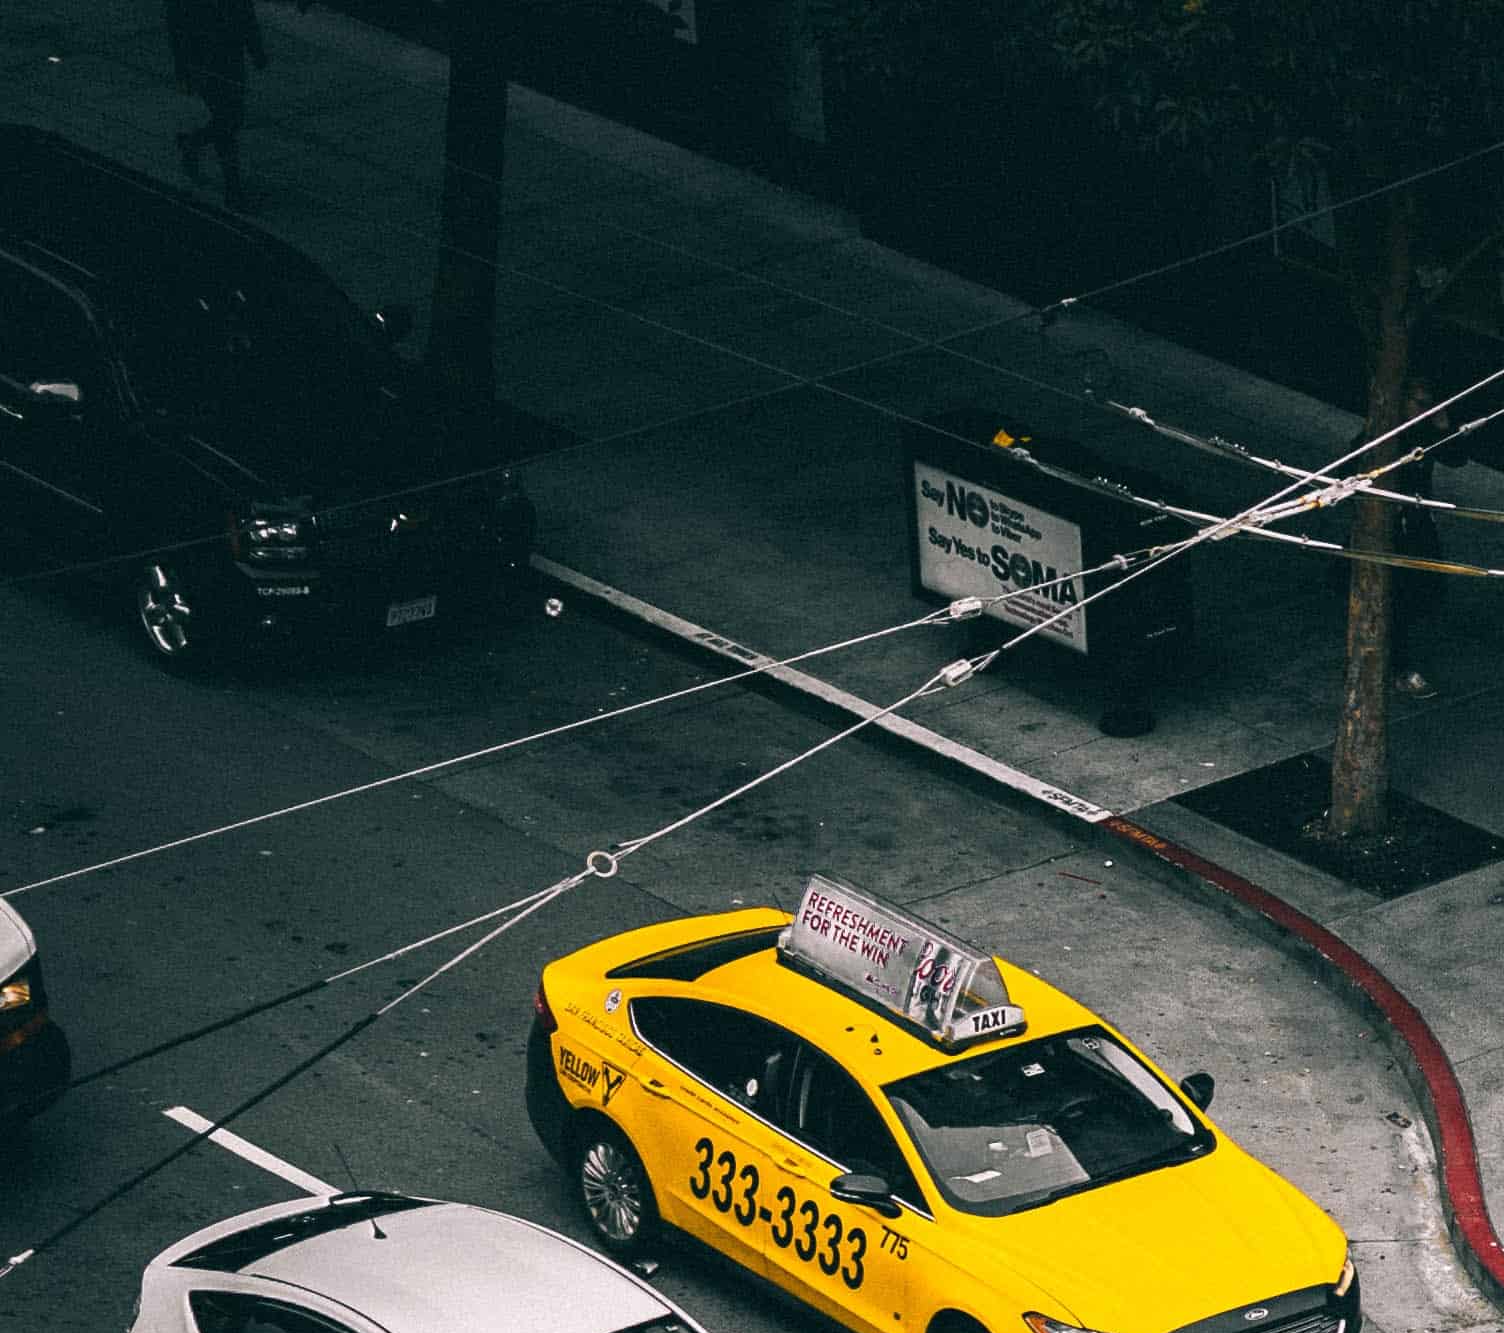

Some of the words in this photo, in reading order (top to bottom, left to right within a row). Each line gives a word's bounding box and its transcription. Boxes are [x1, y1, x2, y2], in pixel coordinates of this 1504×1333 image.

[921, 479, 945, 508] Say
[928, 526, 951, 552] Say
[952, 535, 975, 561] Yes
[976, 547, 990, 568] to
[802, 910, 832, 937] FOR
[833, 925, 859, 953] THE
[861, 942, 890, 969] WIN
[808, 892, 909, 956] REFRESHMENT
[972, 1009, 1007, 1033] TAXI
[559, 1045, 600, 1089] YELLOW
[690, 1137, 867, 1290] 333-3333
[880, 1224, 910, 1261] 775
